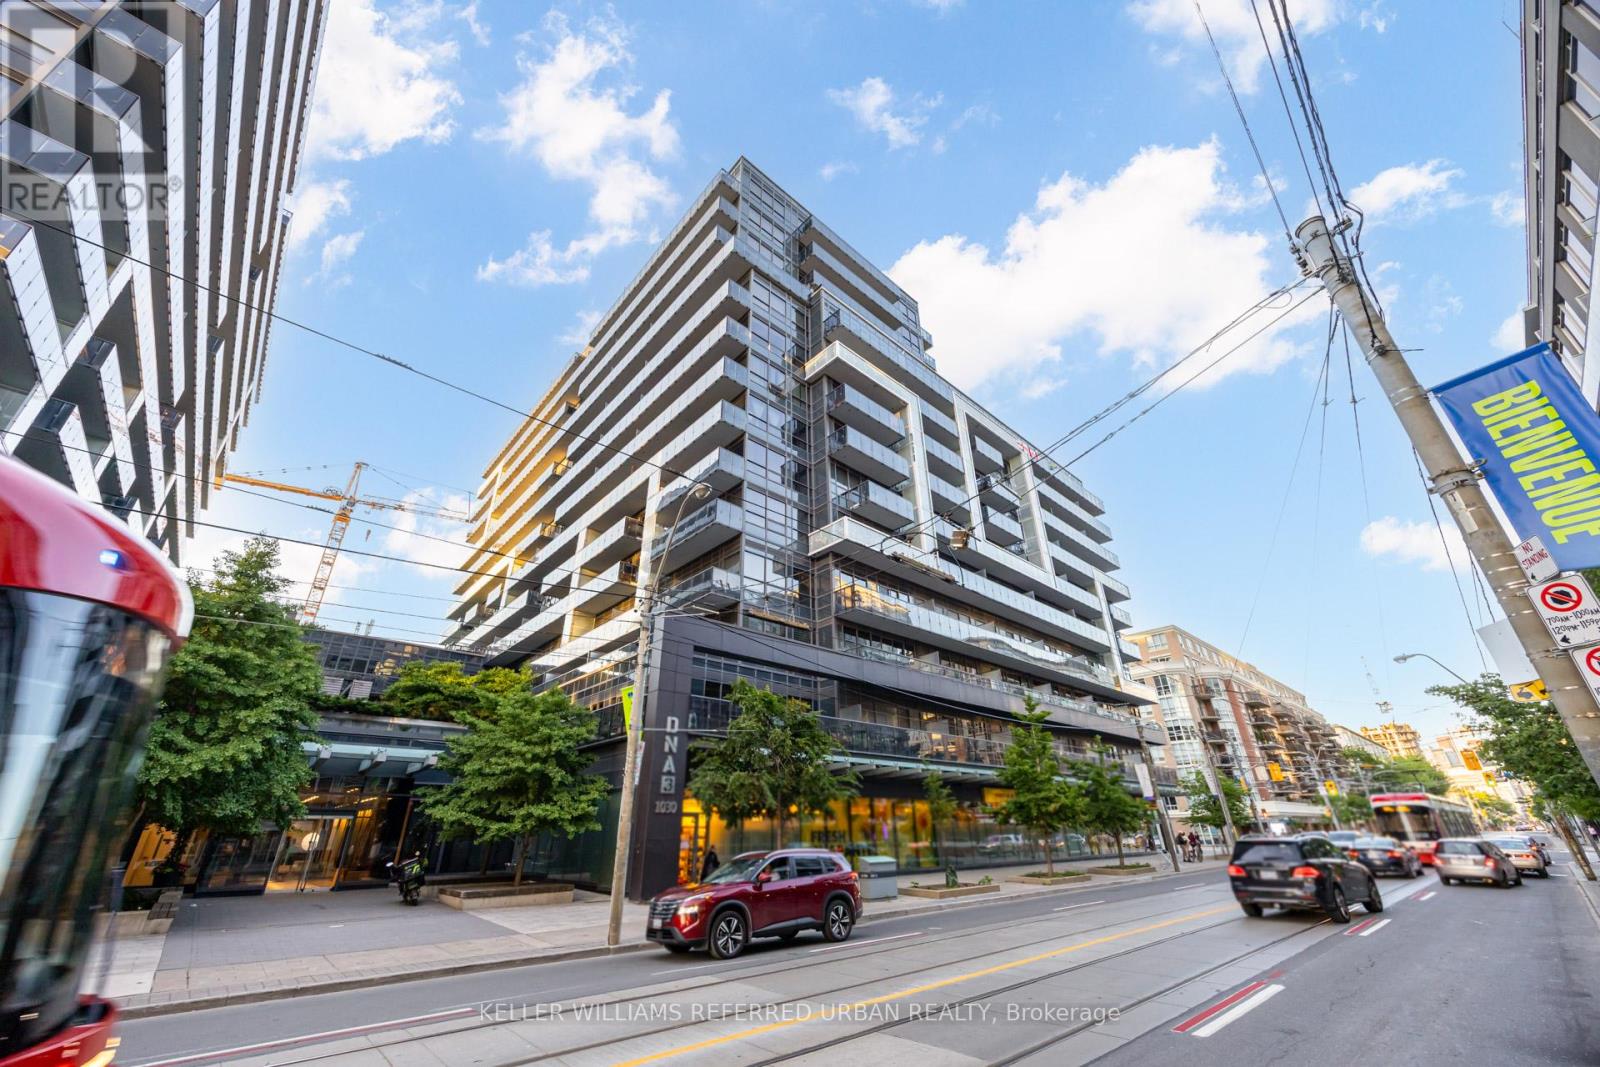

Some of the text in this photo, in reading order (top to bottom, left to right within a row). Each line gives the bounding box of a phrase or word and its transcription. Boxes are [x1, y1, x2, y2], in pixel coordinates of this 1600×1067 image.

[1472, 379, 1600, 544] BIENVENUE
[1521, 542, 1533, 554] NO
[1522, 548, 1548, 569] STANDING
